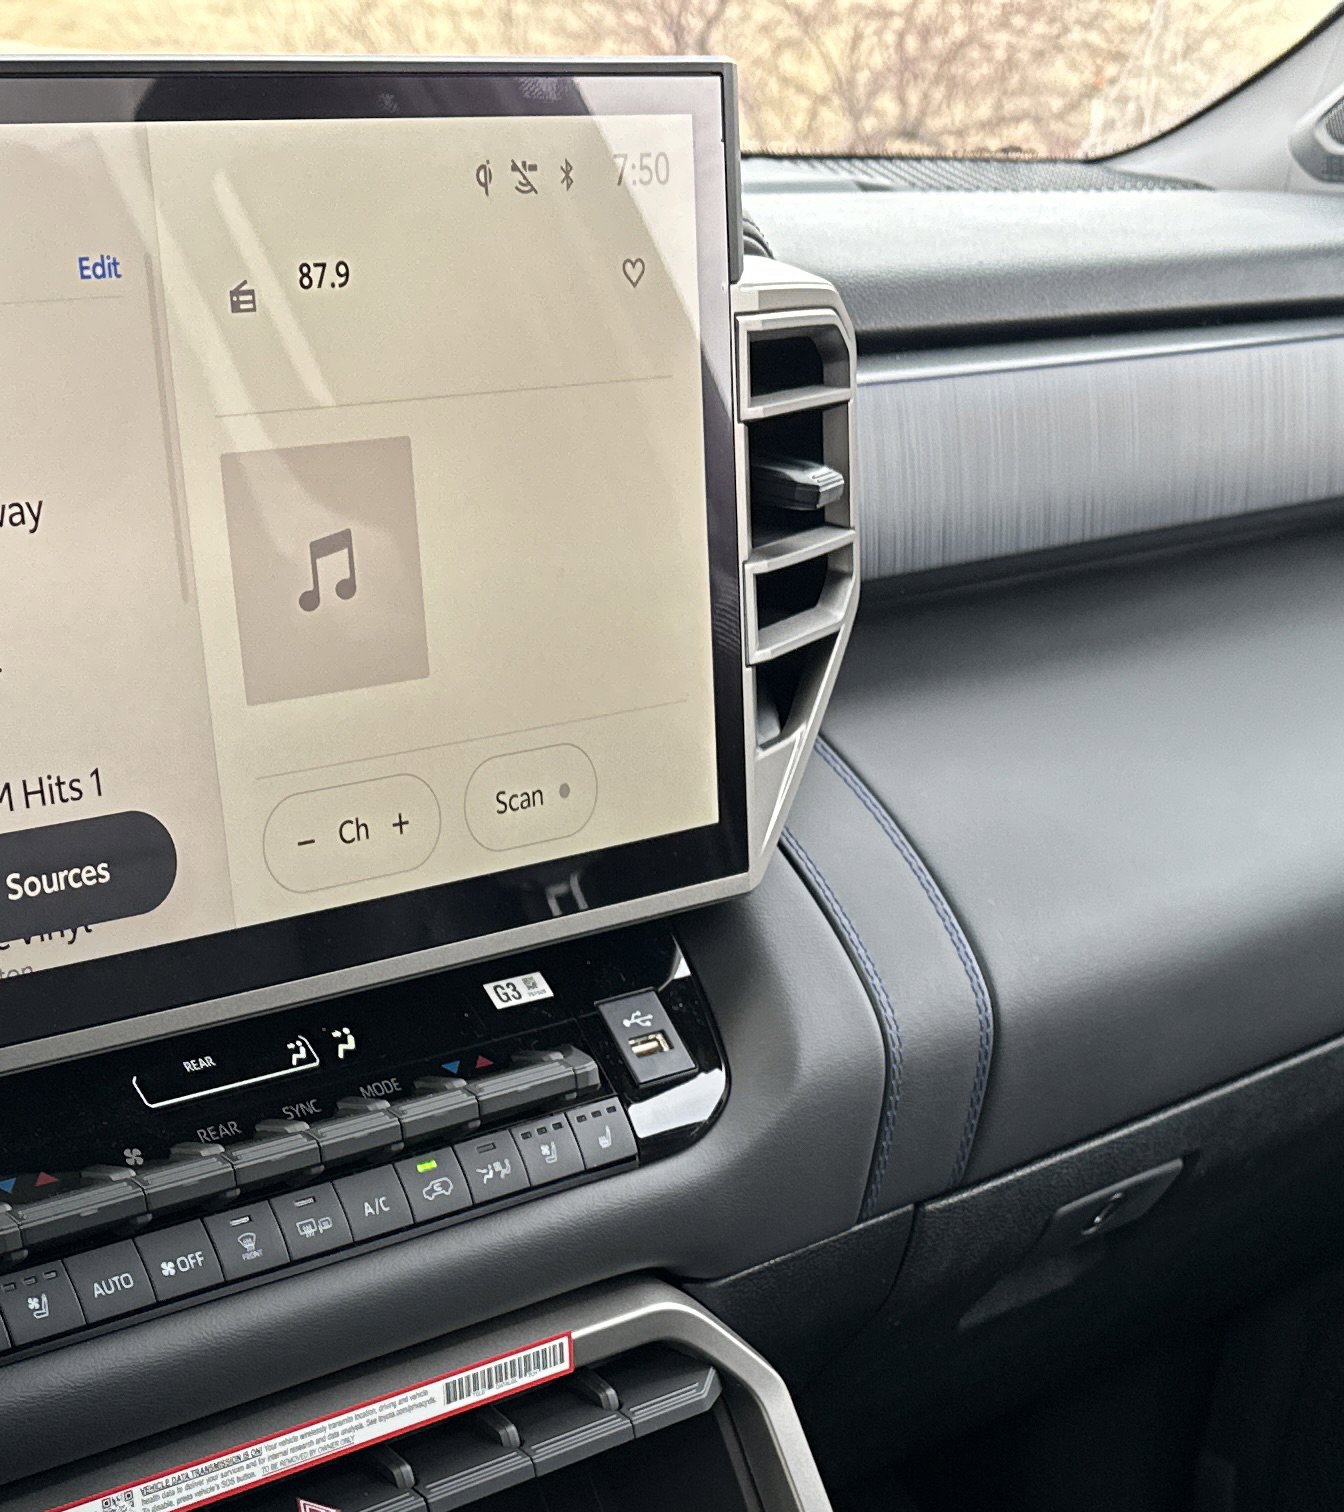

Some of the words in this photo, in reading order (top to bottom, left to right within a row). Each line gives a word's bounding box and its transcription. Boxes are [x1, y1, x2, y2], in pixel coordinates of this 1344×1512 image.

[614, 151, 670, 187] 7:50
[78, 254, 122, 282] Edit
[298, 260, 350, 291] 87.9
[21, 776, 84, 811] Hits
[89, 767, 104, 797] 1
[495, 786, 544, 814] Scan
[338, 819, 369, 844] Ch
[6, 862, 111, 901] Sources
[492, 982, 523, 1003] G3
[182, 1055, 216, 1072] REAR
[359, 1077, 402, 1099] MODE
[281, 1099, 322, 1120] SYNC
[196, 1121, 243, 1143] REAR
[363, 1196, 391, 1218] A/C
[176, 1251, 204, 1273] OFF
[92, 1272, 134, 1299] AUTO
